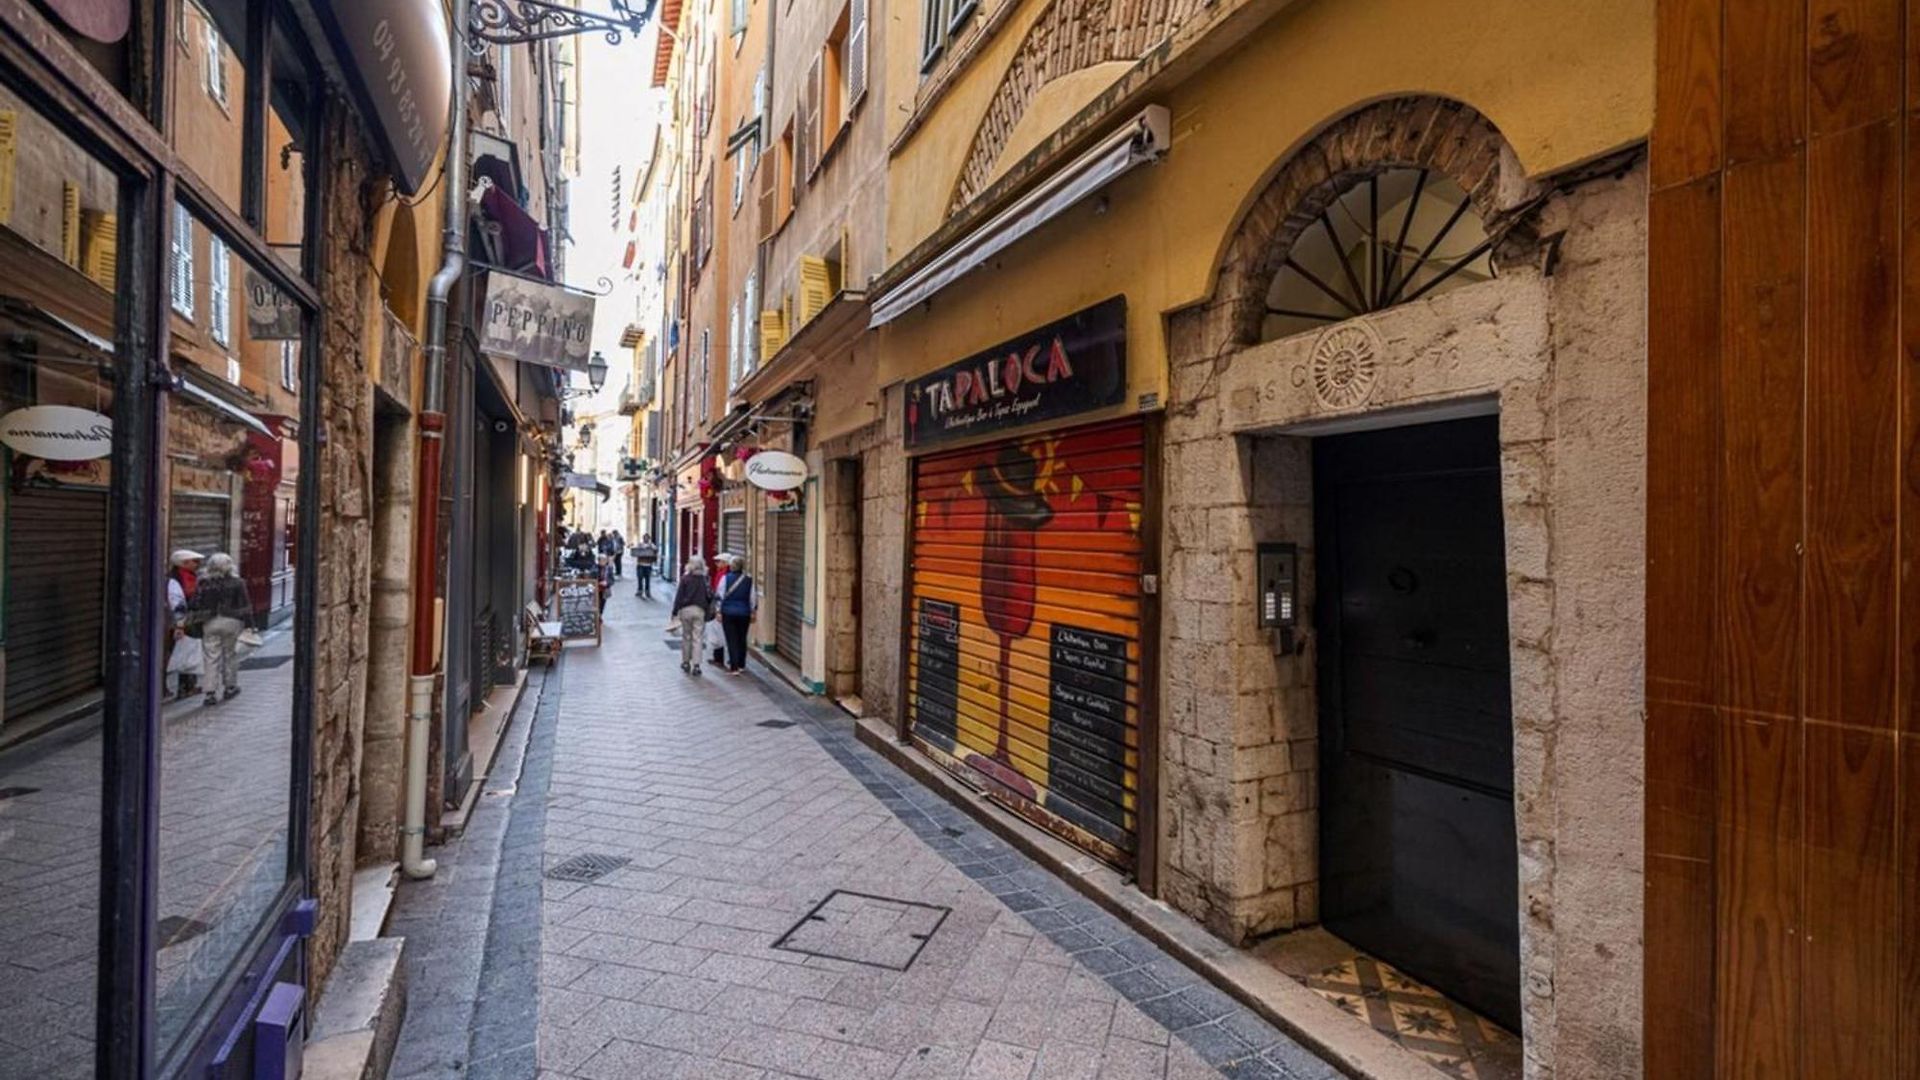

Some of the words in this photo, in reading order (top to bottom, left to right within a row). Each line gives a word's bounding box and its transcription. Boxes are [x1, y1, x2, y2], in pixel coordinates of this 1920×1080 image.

[372, 20, 395, 62] 04
[387, 59, 407, 95] 93
[925, 335, 1074, 421] TAPALOCA
